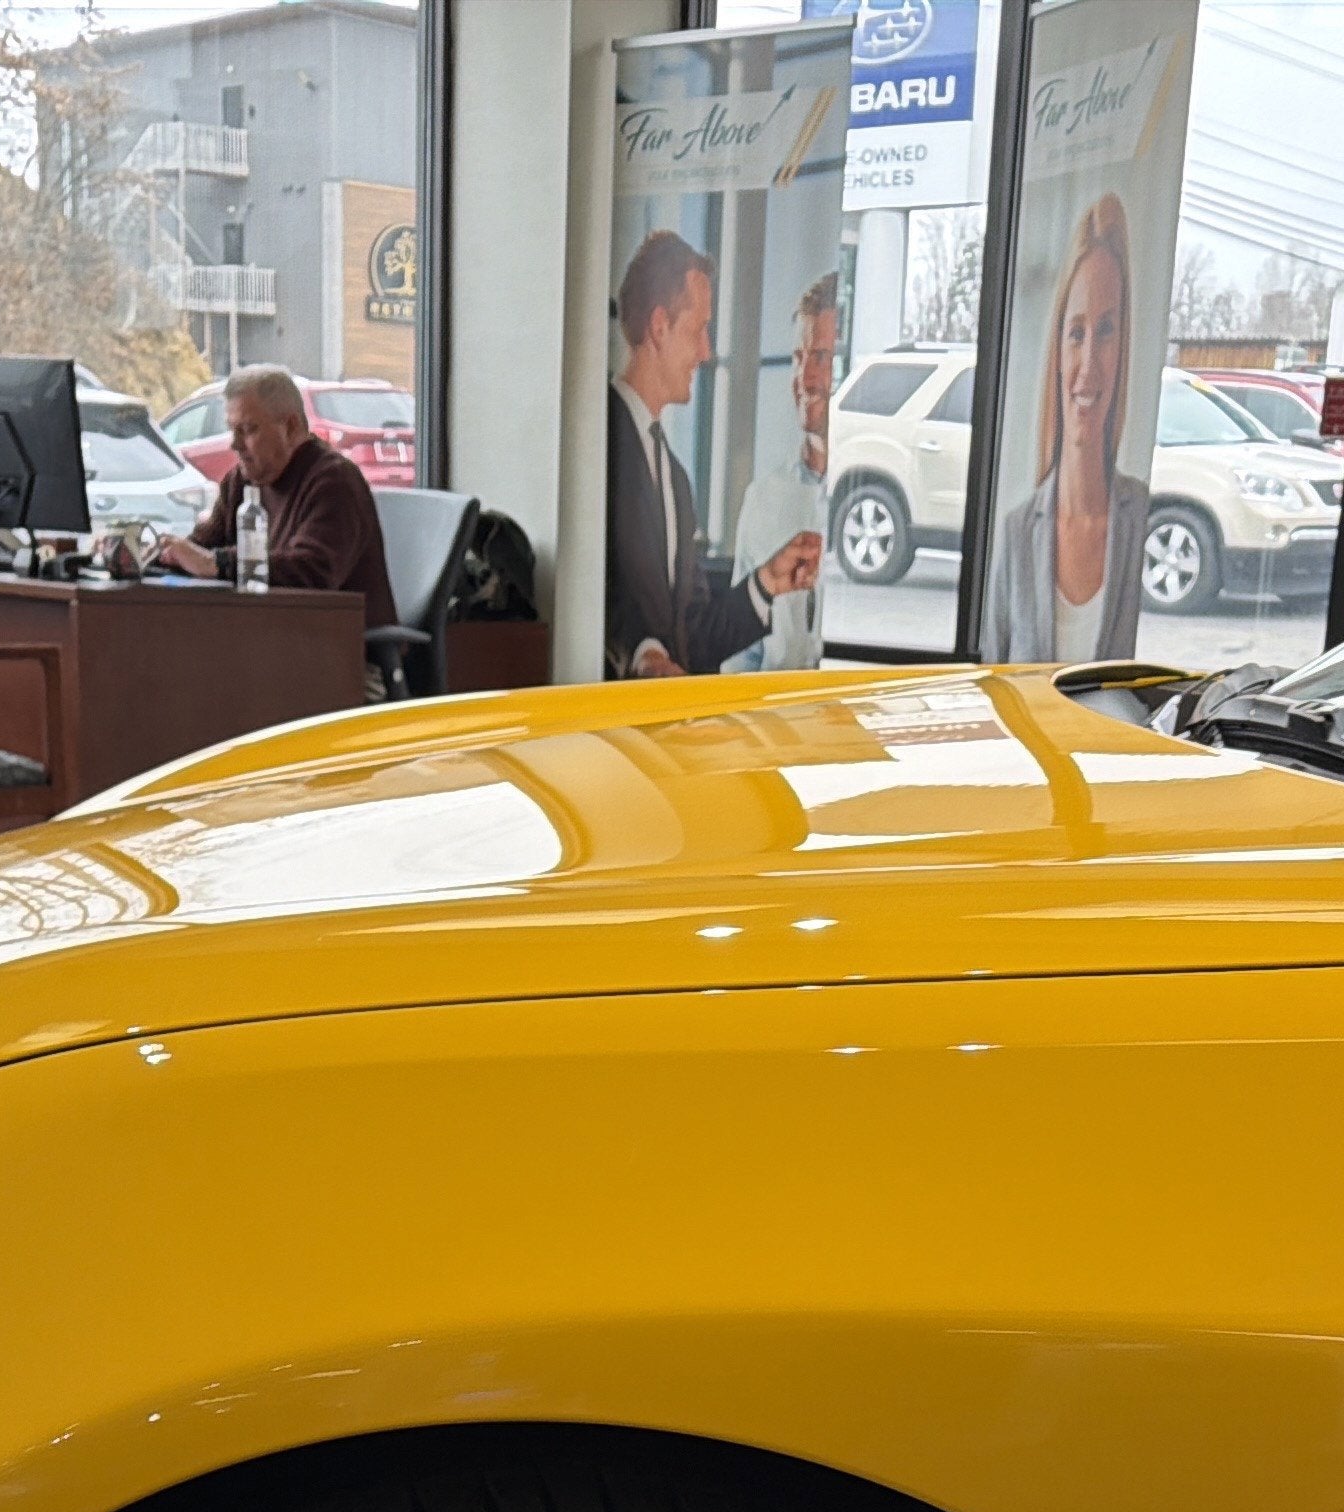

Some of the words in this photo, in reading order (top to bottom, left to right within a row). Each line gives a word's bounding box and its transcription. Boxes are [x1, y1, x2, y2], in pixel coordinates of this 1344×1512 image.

[850, 75, 956, 113] BARU
[1033, 78, 1068, 140] Far
[1066, 65, 1134, 136] Above
[619, 106, 673, 162] Far
[673, 102, 766, 161] Above
[845, 144, 928, 166] E-OWNED
[844, 168, 914, 189] EHICLES
